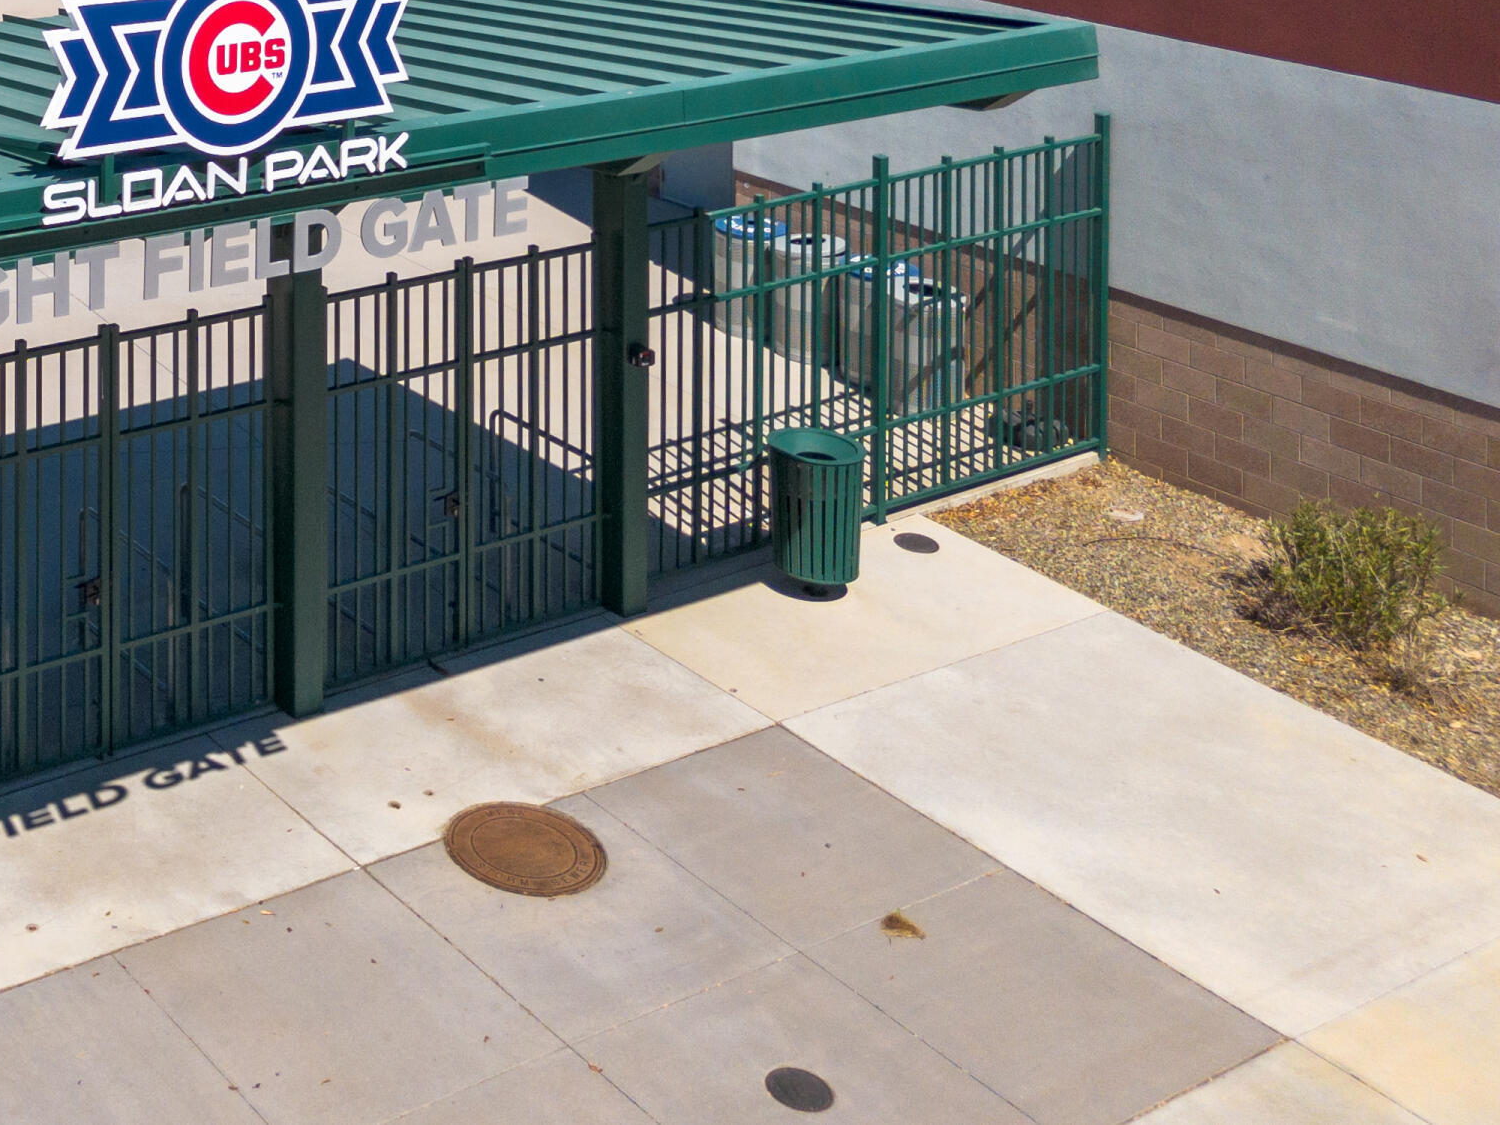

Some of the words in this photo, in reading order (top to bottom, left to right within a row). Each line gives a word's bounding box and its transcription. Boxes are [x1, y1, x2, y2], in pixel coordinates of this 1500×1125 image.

[189, 0, 286, 116] CUBS
[42, 156, 248, 225] SLOAN
[265, 131, 409, 192] PARK
[143, 208, 342, 300] FIELD
[360, 175, 529, 260] GATE
[142, 730, 287, 791] GATE
